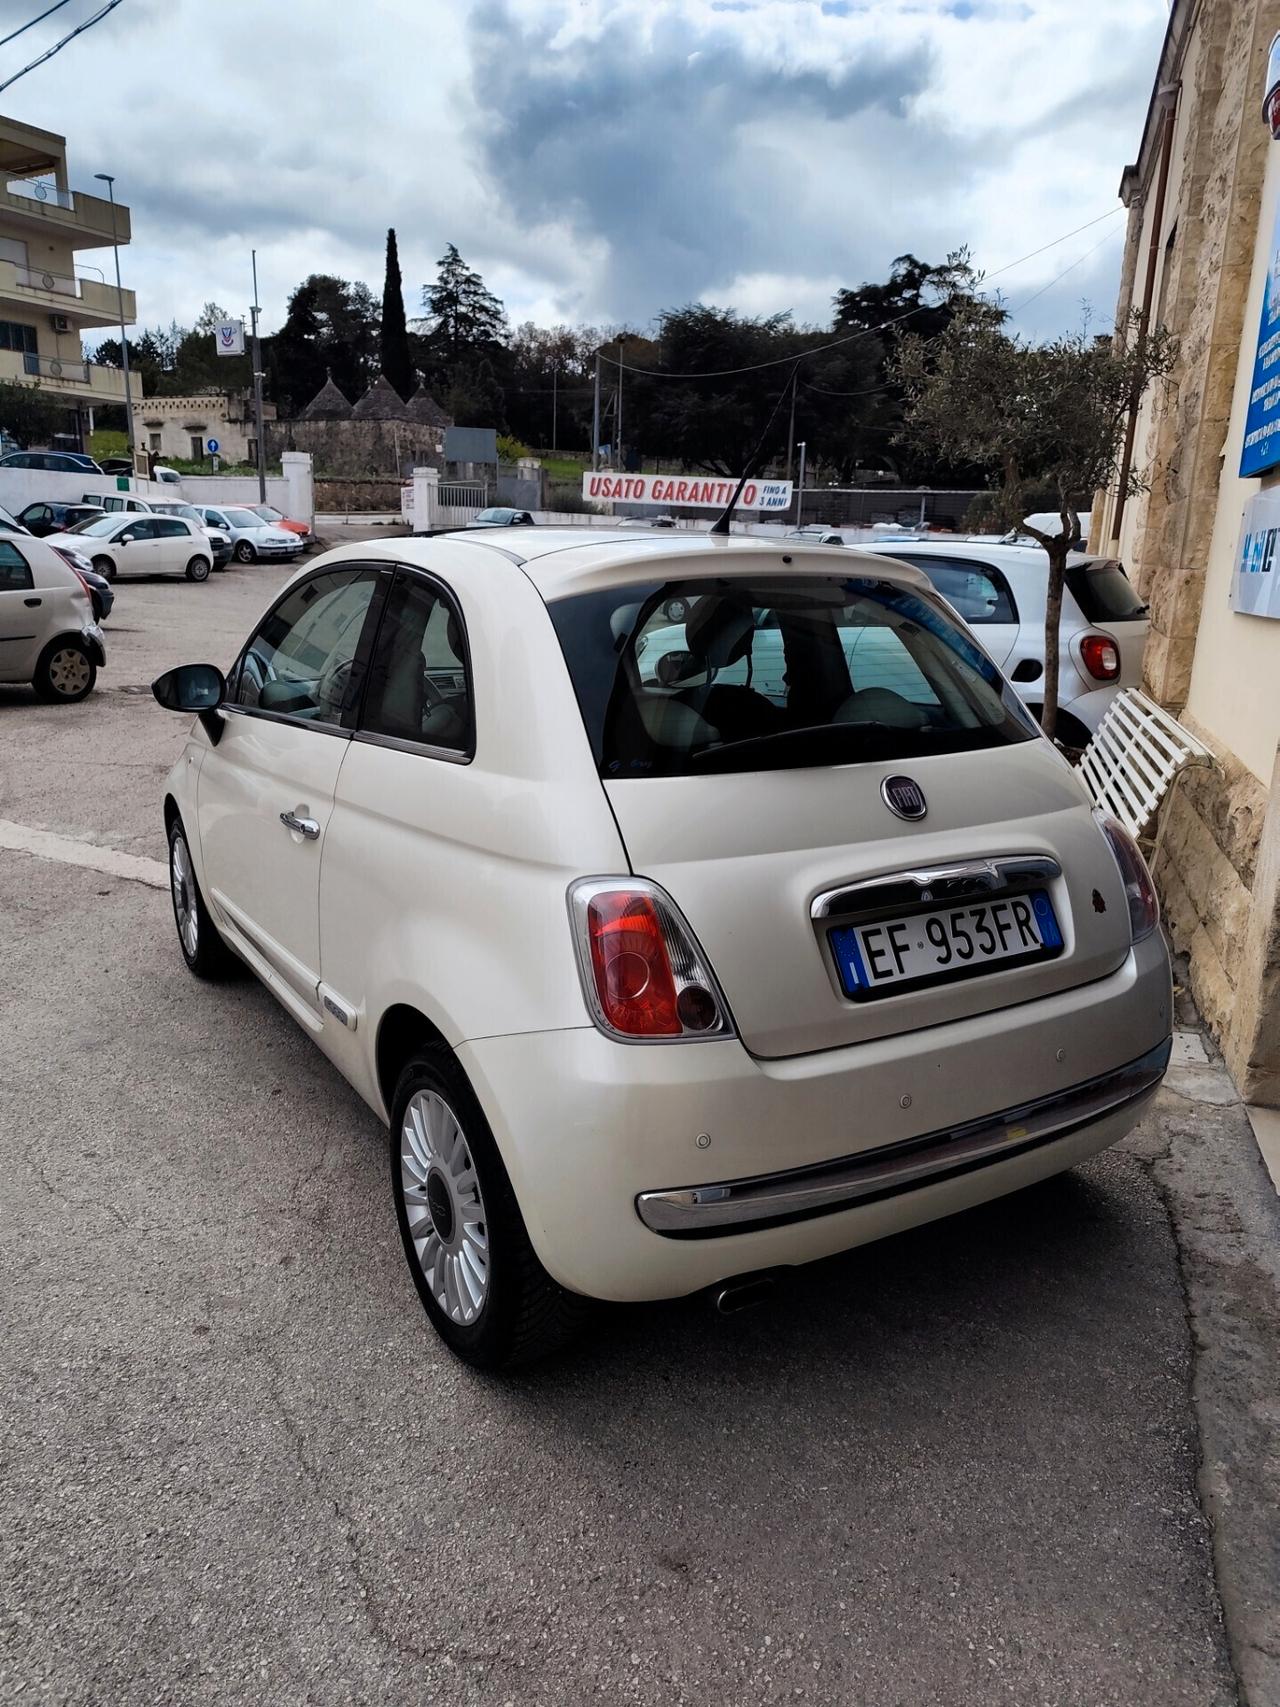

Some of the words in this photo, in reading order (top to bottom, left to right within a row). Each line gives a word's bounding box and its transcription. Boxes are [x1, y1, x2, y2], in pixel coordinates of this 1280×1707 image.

[589, 477, 646, 499] USATO
[651, 480, 758, 505] GARANTIO
[763, 485, 779, 495] FINO
[780, 486, 787, 495] A
[759, 496, 765, 506] 3
[766, 497, 788, 507] ANNI
[891, 786, 920, 808] FIAT
